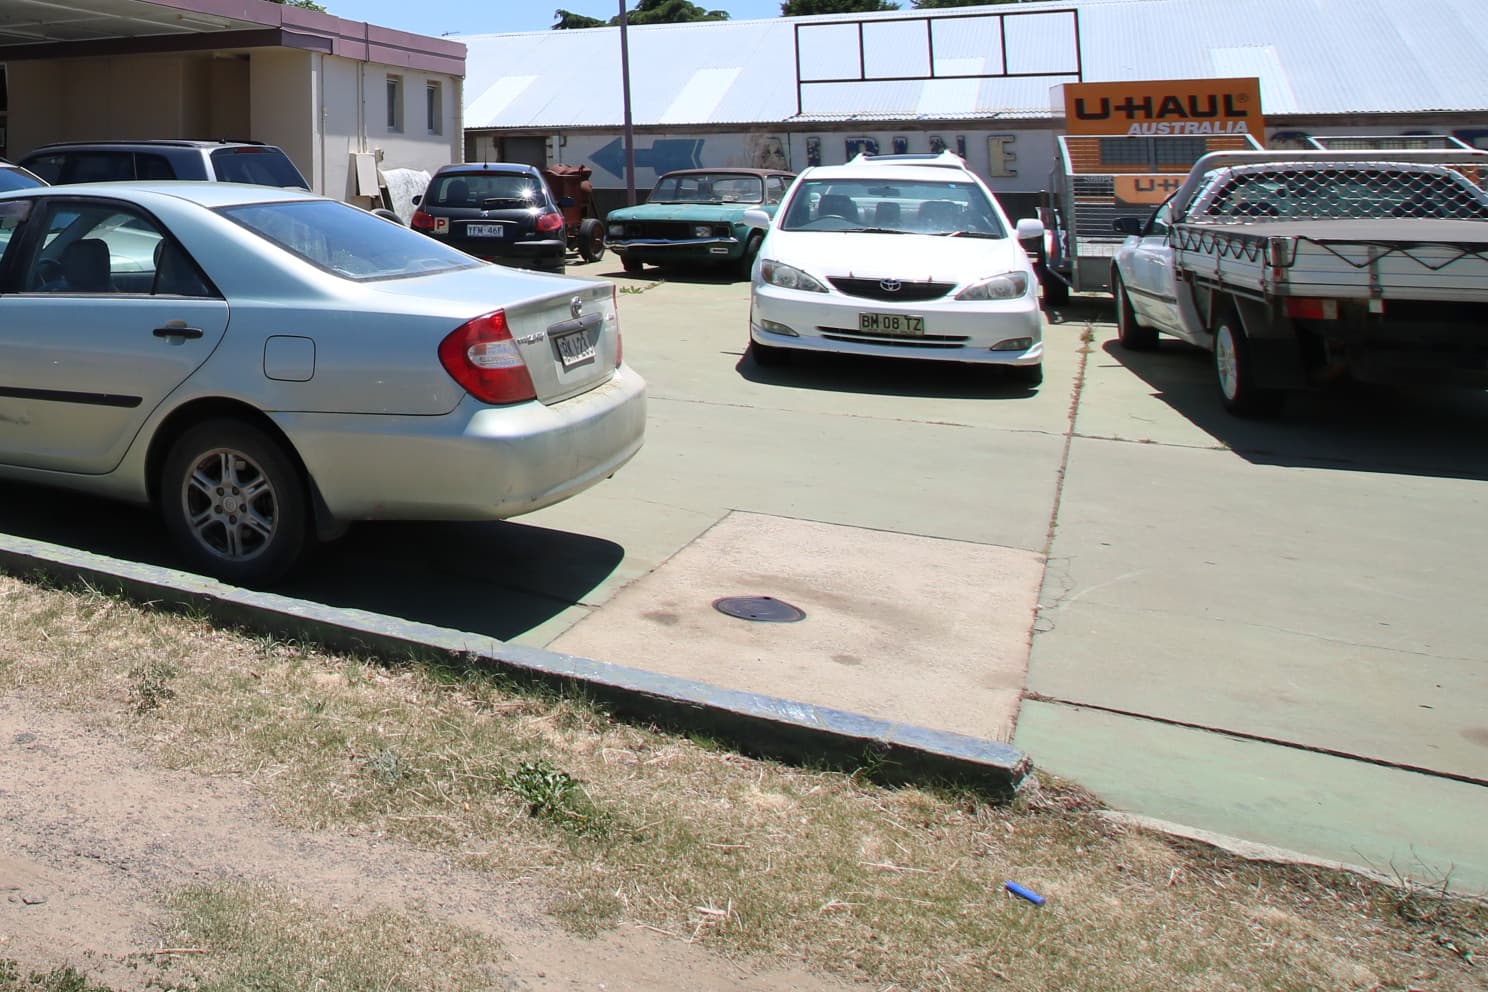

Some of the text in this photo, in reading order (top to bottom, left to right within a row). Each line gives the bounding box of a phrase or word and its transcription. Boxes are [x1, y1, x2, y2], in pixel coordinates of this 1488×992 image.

[1075, 94, 1248, 120] U-HAUL
[1128, 121, 1249, 135] AUSTRALIA
[1135, 178, 1180, 192] U-H
[862, 314, 922, 331] BM 08 TZ
